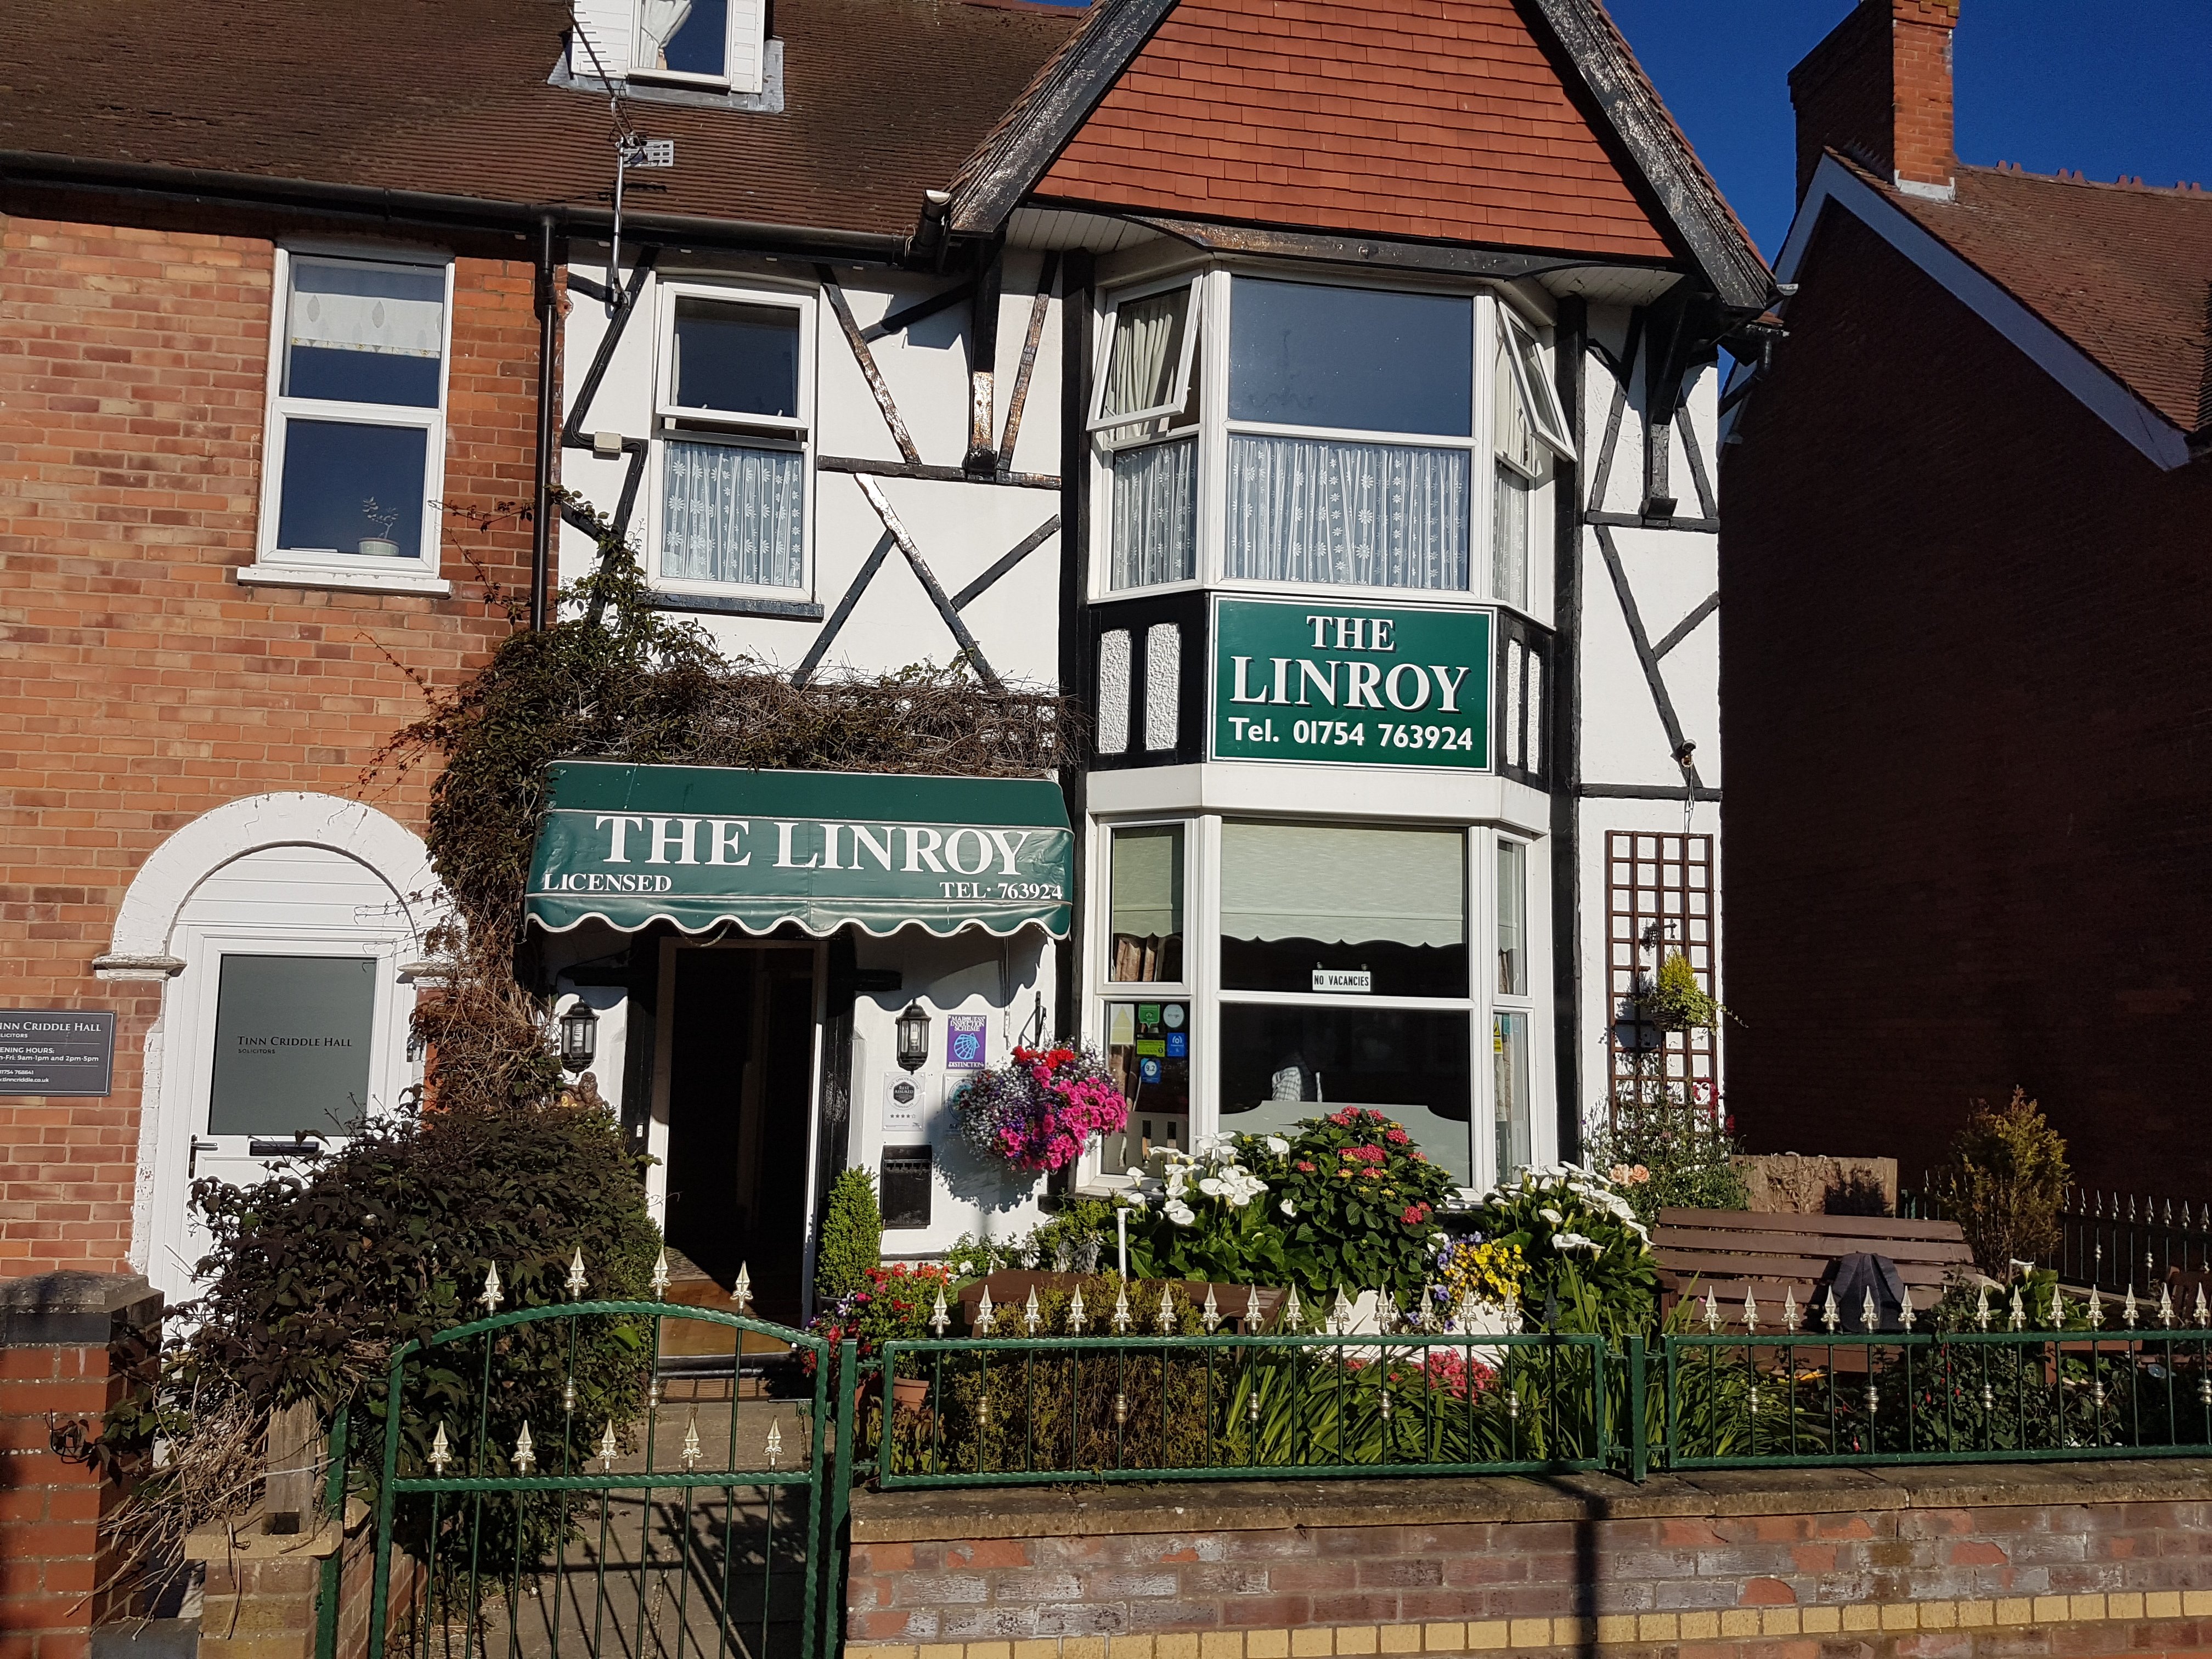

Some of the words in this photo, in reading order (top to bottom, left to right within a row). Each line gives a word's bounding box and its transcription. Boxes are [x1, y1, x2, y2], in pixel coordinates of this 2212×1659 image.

[1306, 616, 1396, 652] THE
[1229, 656, 1471, 713] LINROY
[1228, 717, 1279, 742] Tel.
[1293, 720, 1364, 746] 01754
[1378, 724, 1473, 751] 763924
[595, 815, 752, 866] THE
[772, 822, 1032, 876] LINROY
[541, 873, 672, 892] LICENSED
[997, 883, 1063, 900] 763924
[1314, 975, 1324, 985] NO
[1328, 975, 1369, 986] VACANCIES
[23, 1022, 71, 1031] CRIDDLE
[74, 1023, 101, 1031] HALL
[238, 1036, 267, 1045] TINN
[270, 1036, 320, 1046] CRIDDLE
[324, 1037, 352, 1047] HALL
